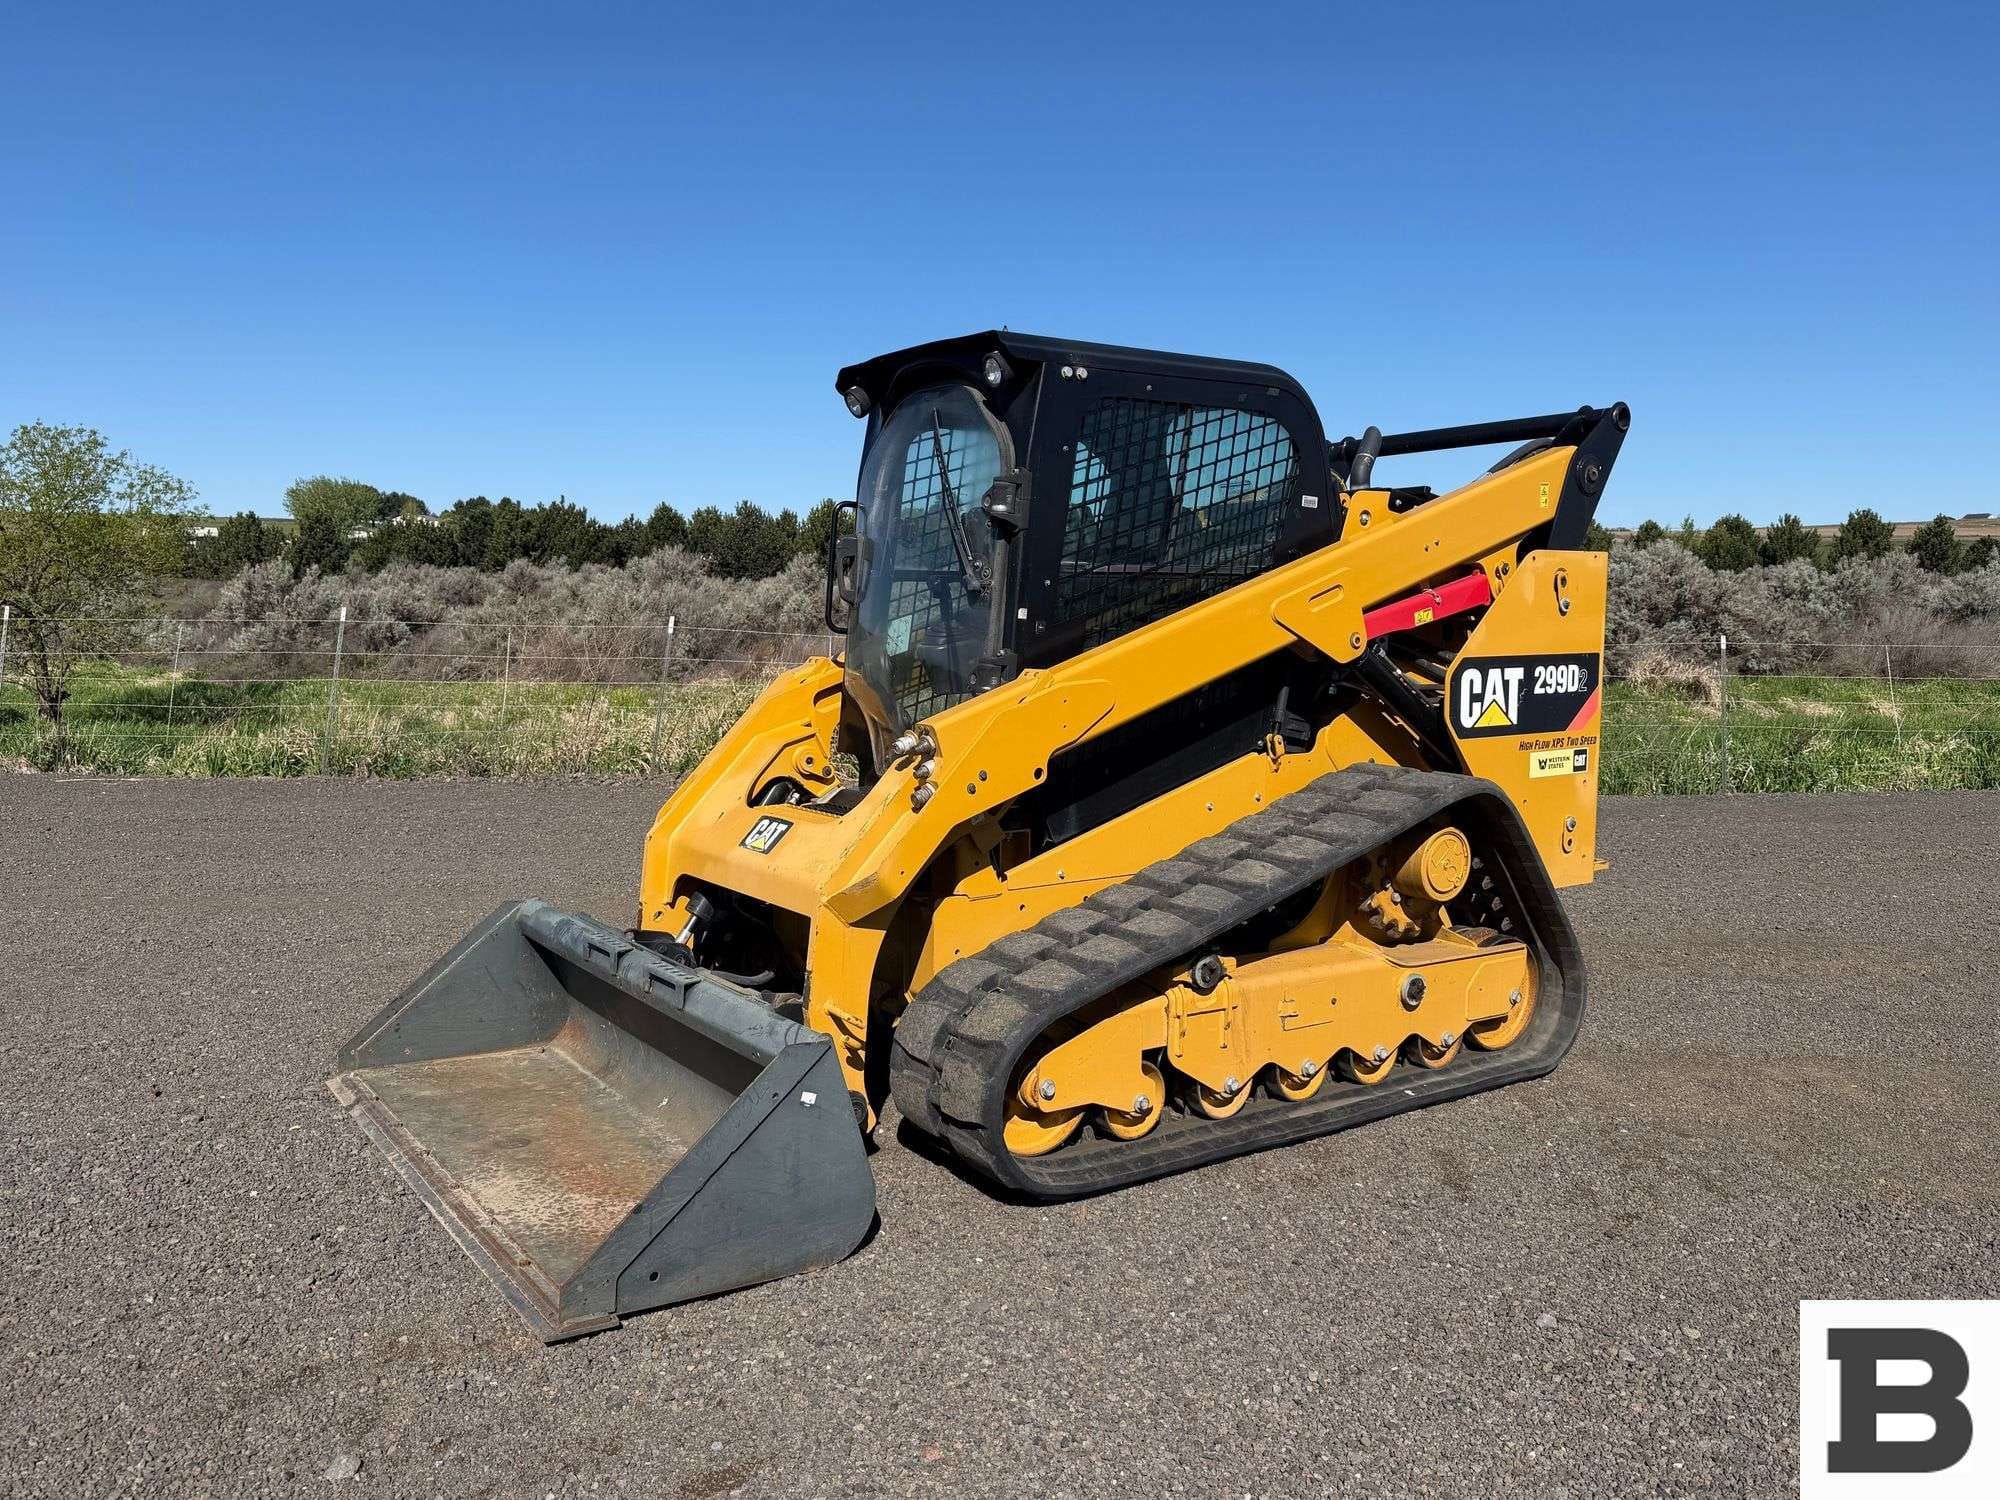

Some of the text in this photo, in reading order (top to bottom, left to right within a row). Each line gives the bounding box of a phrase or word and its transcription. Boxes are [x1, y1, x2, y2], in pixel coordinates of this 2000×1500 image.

[1460, 664, 1588, 729] CAT 299D2
[1551, 737, 1565, 748] XPS
[1574, 754, 1587, 767] CAT
[744, 818, 788, 850] CAT
